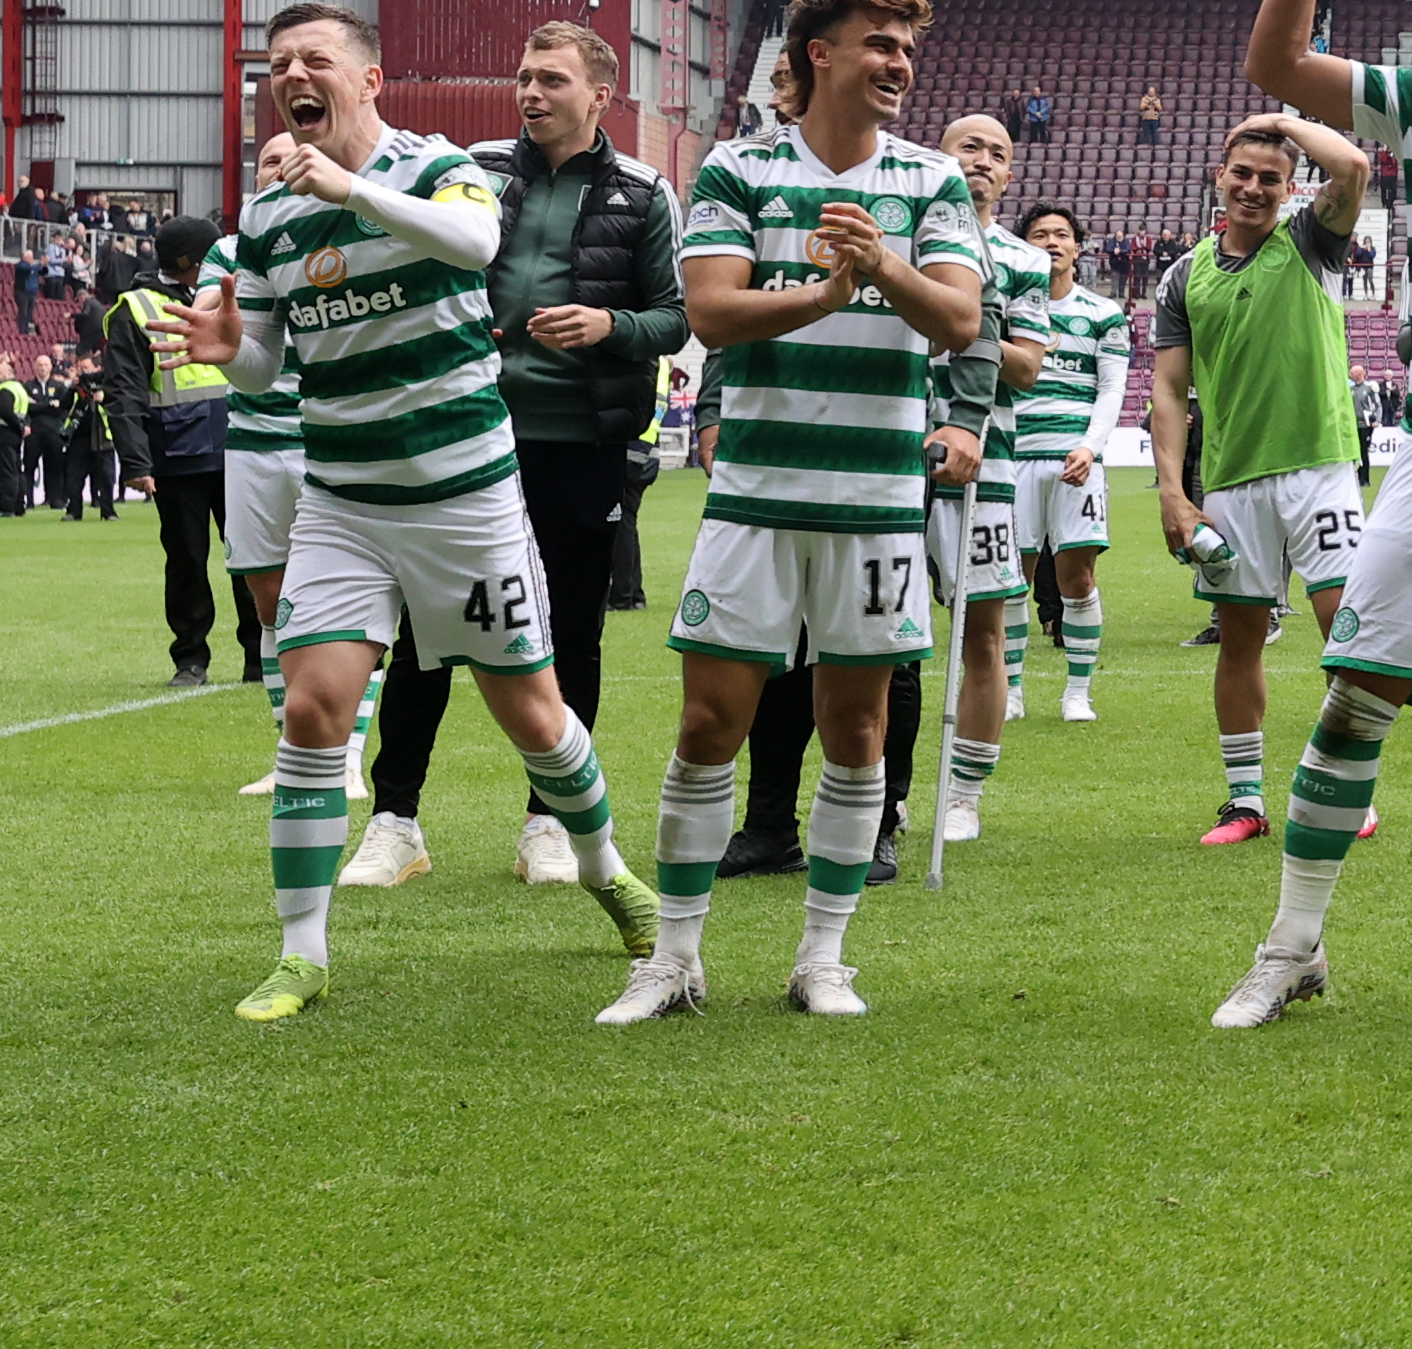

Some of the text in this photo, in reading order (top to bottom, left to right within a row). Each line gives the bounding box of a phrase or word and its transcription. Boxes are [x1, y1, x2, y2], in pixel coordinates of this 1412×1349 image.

[462, 183, 488, 204] C
[271, 243, 297, 256] adidas
[289, 282, 407, 329] dafabet
[1042, 354, 1083, 371] abet
[1081, 494, 1105, 522] 41
[970, 524, 1010, 566] 38
[1315, 510, 1361, 551] 25
[463, 574, 532, 633] 42
[862, 556, 912, 617] 17
